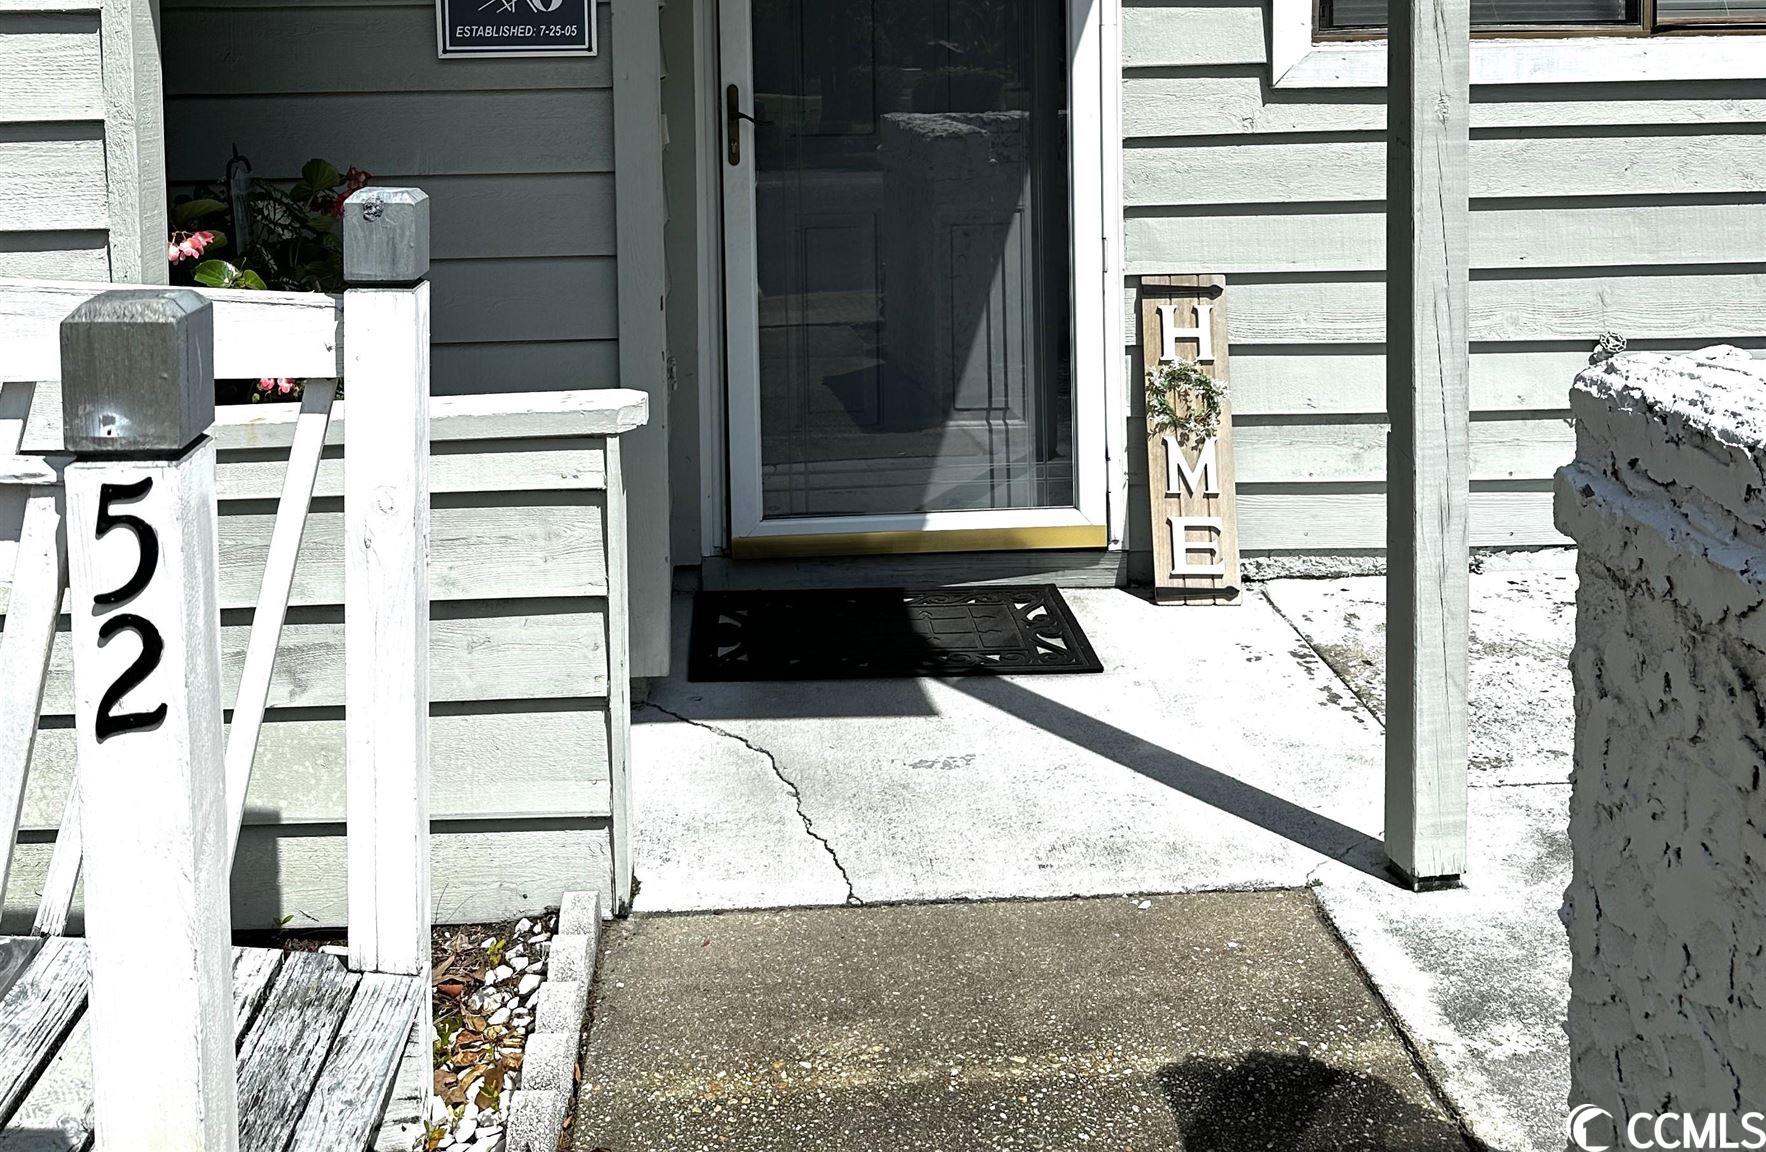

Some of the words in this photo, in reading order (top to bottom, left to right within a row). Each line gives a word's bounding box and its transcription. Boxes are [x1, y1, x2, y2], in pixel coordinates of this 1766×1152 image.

[455, 25, 536, 38] ESTABLISHED:
[539, 25, 578, 37] 7-25-05
[92, 476, 168, 744] 52
